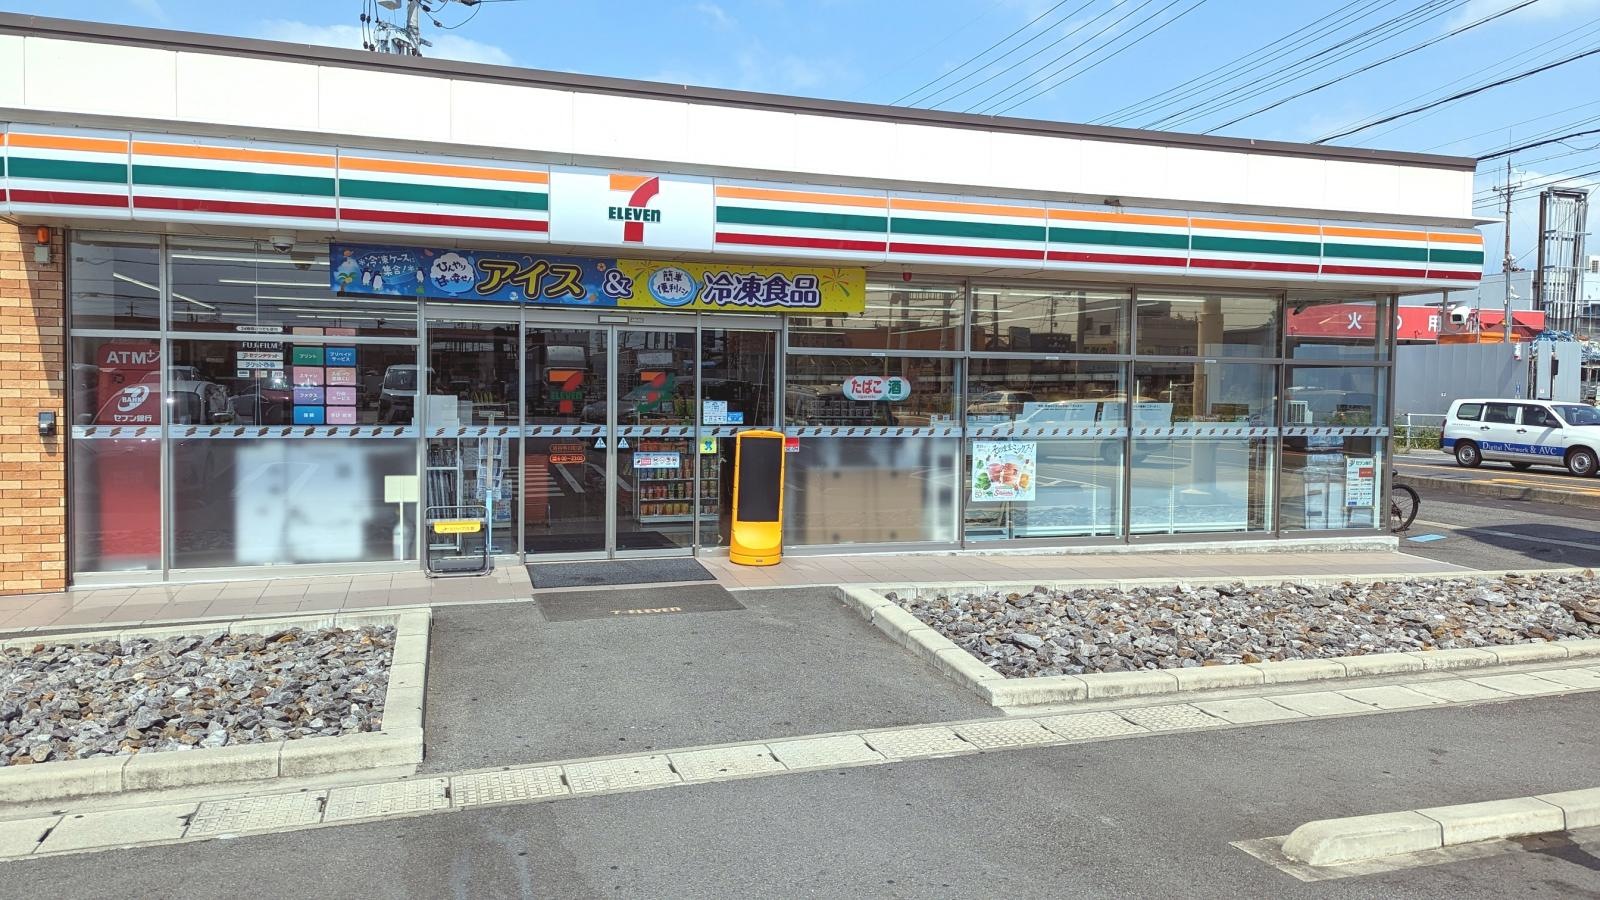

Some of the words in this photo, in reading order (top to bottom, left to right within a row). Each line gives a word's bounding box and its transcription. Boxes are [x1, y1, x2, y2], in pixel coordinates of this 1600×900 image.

[436, 261, 466, 272] ひんやり
[476, 260, 585, 299] アイス
[662, 270, 684, 282] 簡単
[602, 269, 633, 299] &
[702, 272, 820, 305] 冷凍食品
[851, 380, 882, 394] たばこ
[888, 380, 902, 394] 酒
[113, 414, 152, 422] セブン銀行
[1539, 446, 1558, 456] AVC
